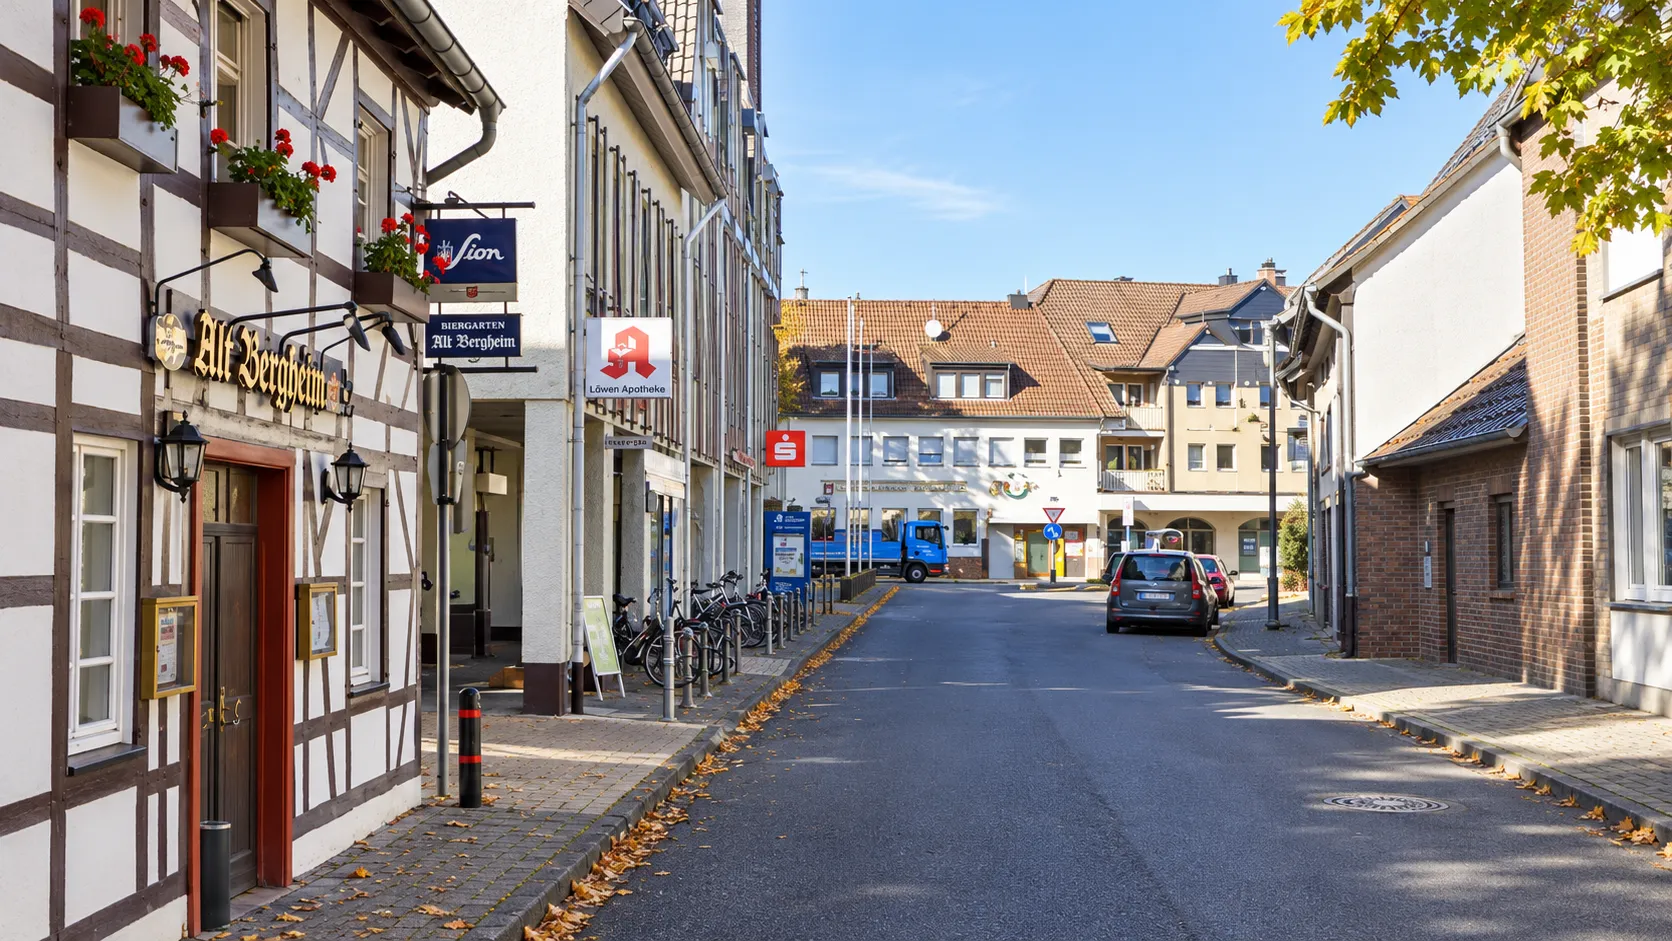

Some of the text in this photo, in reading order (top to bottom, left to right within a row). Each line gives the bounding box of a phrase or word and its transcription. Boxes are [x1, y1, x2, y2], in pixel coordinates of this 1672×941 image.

[445, 233, 504, 270] Sion
[441, 321, 505, 330] BIERGARTEN
[431, 334, 516, 350] Alt Bergheim
[194, 309, 327, 412] Alt Bergheim
[621, 385, 665, 395] Apotheke
